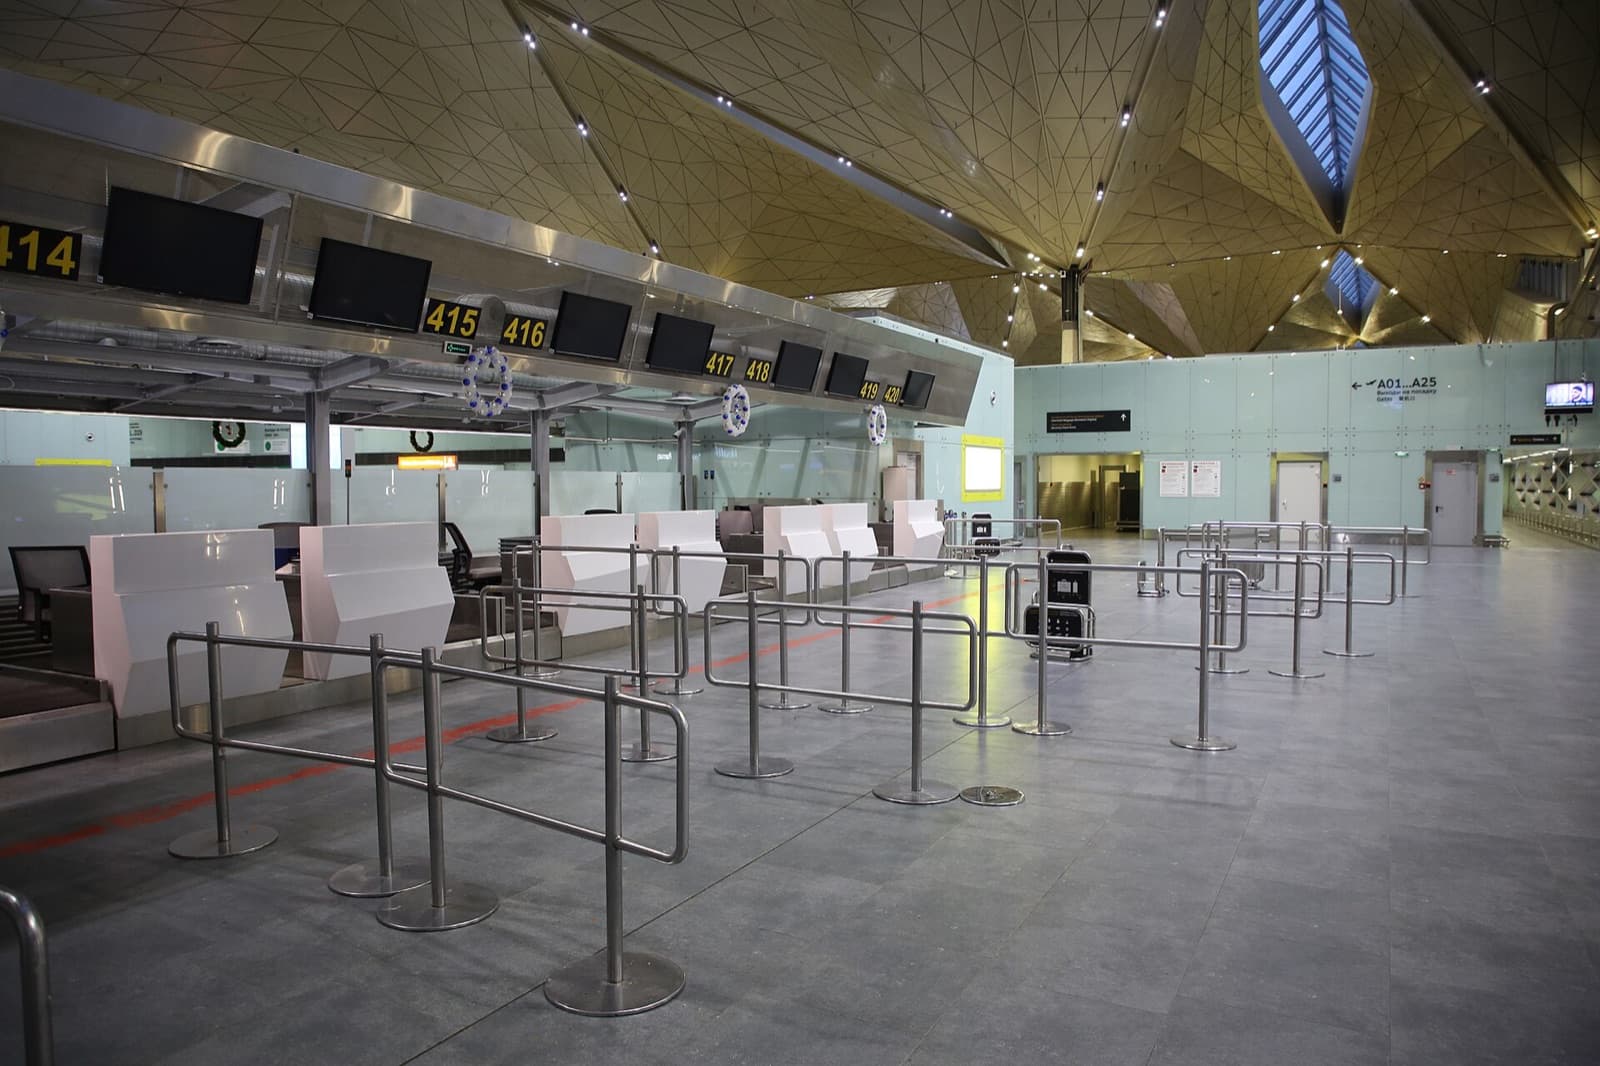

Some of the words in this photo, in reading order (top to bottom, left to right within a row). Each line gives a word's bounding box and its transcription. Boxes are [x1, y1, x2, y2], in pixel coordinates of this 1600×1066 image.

[426, 303, 479, 337] 415
[503, 317, 545, 348] 416
[706, 352, 734, 376] 417
[746, 360, 770, 382] 418
[860, 381, 878, 400] 419
[884, 386, 900, 403] 420
